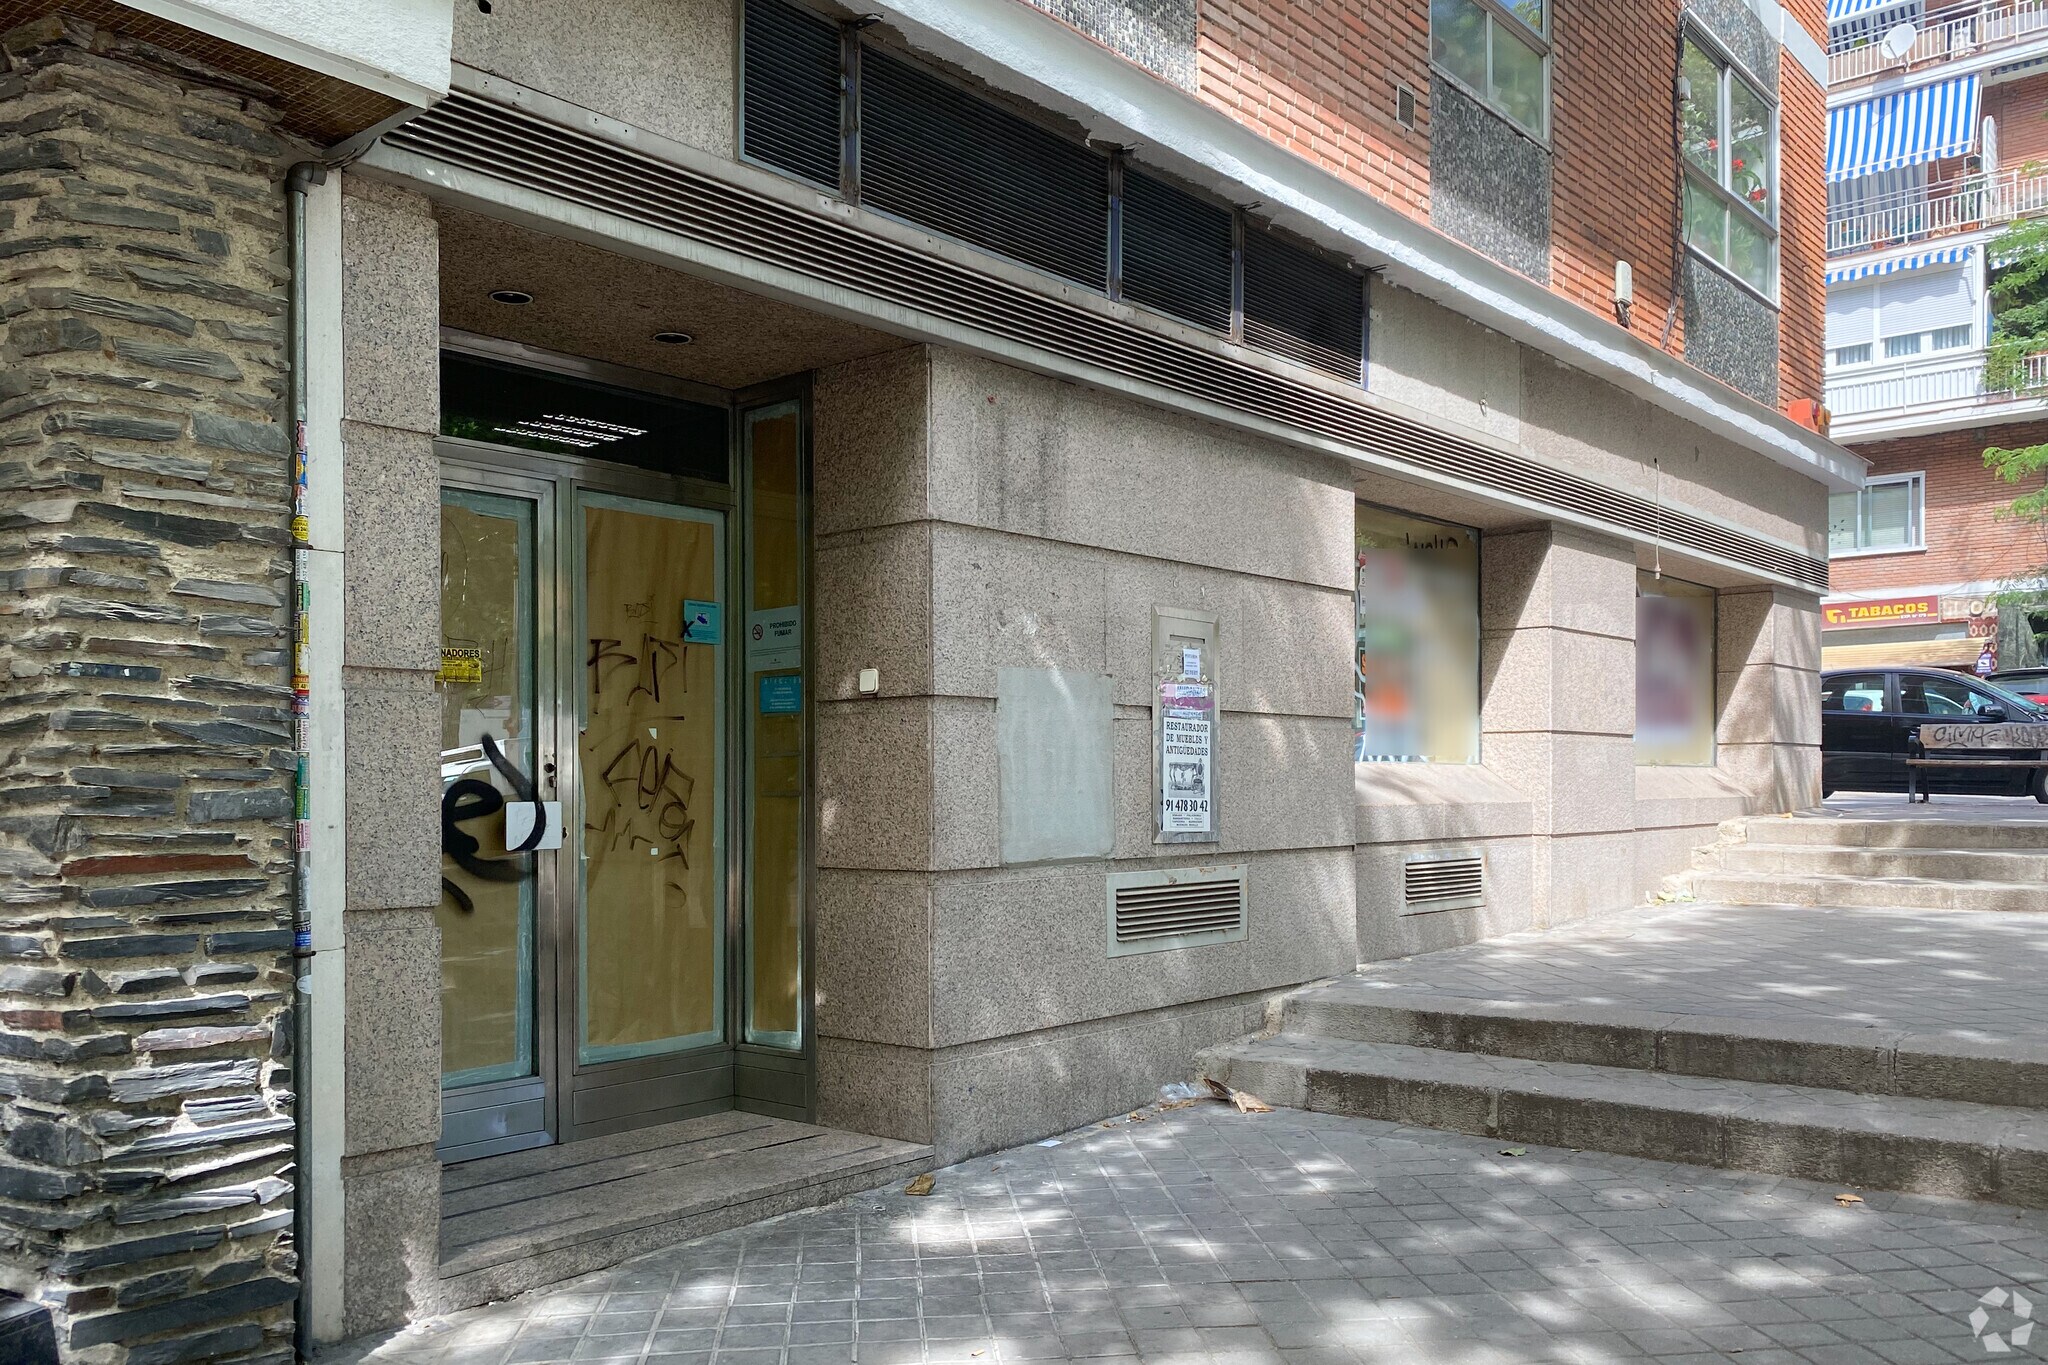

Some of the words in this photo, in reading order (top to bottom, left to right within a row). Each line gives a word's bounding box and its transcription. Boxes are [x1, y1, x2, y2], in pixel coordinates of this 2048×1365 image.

[1848, 603, 1928, 617] TABACOS
[769, 620, 797, 629] PROHIBIDO
[774, 629, 792, 637] FUMAR
[1166, 721, 1209, 733] RESTAURADOR
[1166, 733, 1174, 742] DE
[1176, 734, 1202, 744] MUEBLES
[1204, 735, 1209, 744] Y
[1166, 744, 1209, 756] ANTIGÜEDADES
[1165, 799, 1174, 811] 91
[1175, 799, 1188, 812] 478
[1189, 799, 1198, 812] 30
[1199, 800, 1208, 812] 42
